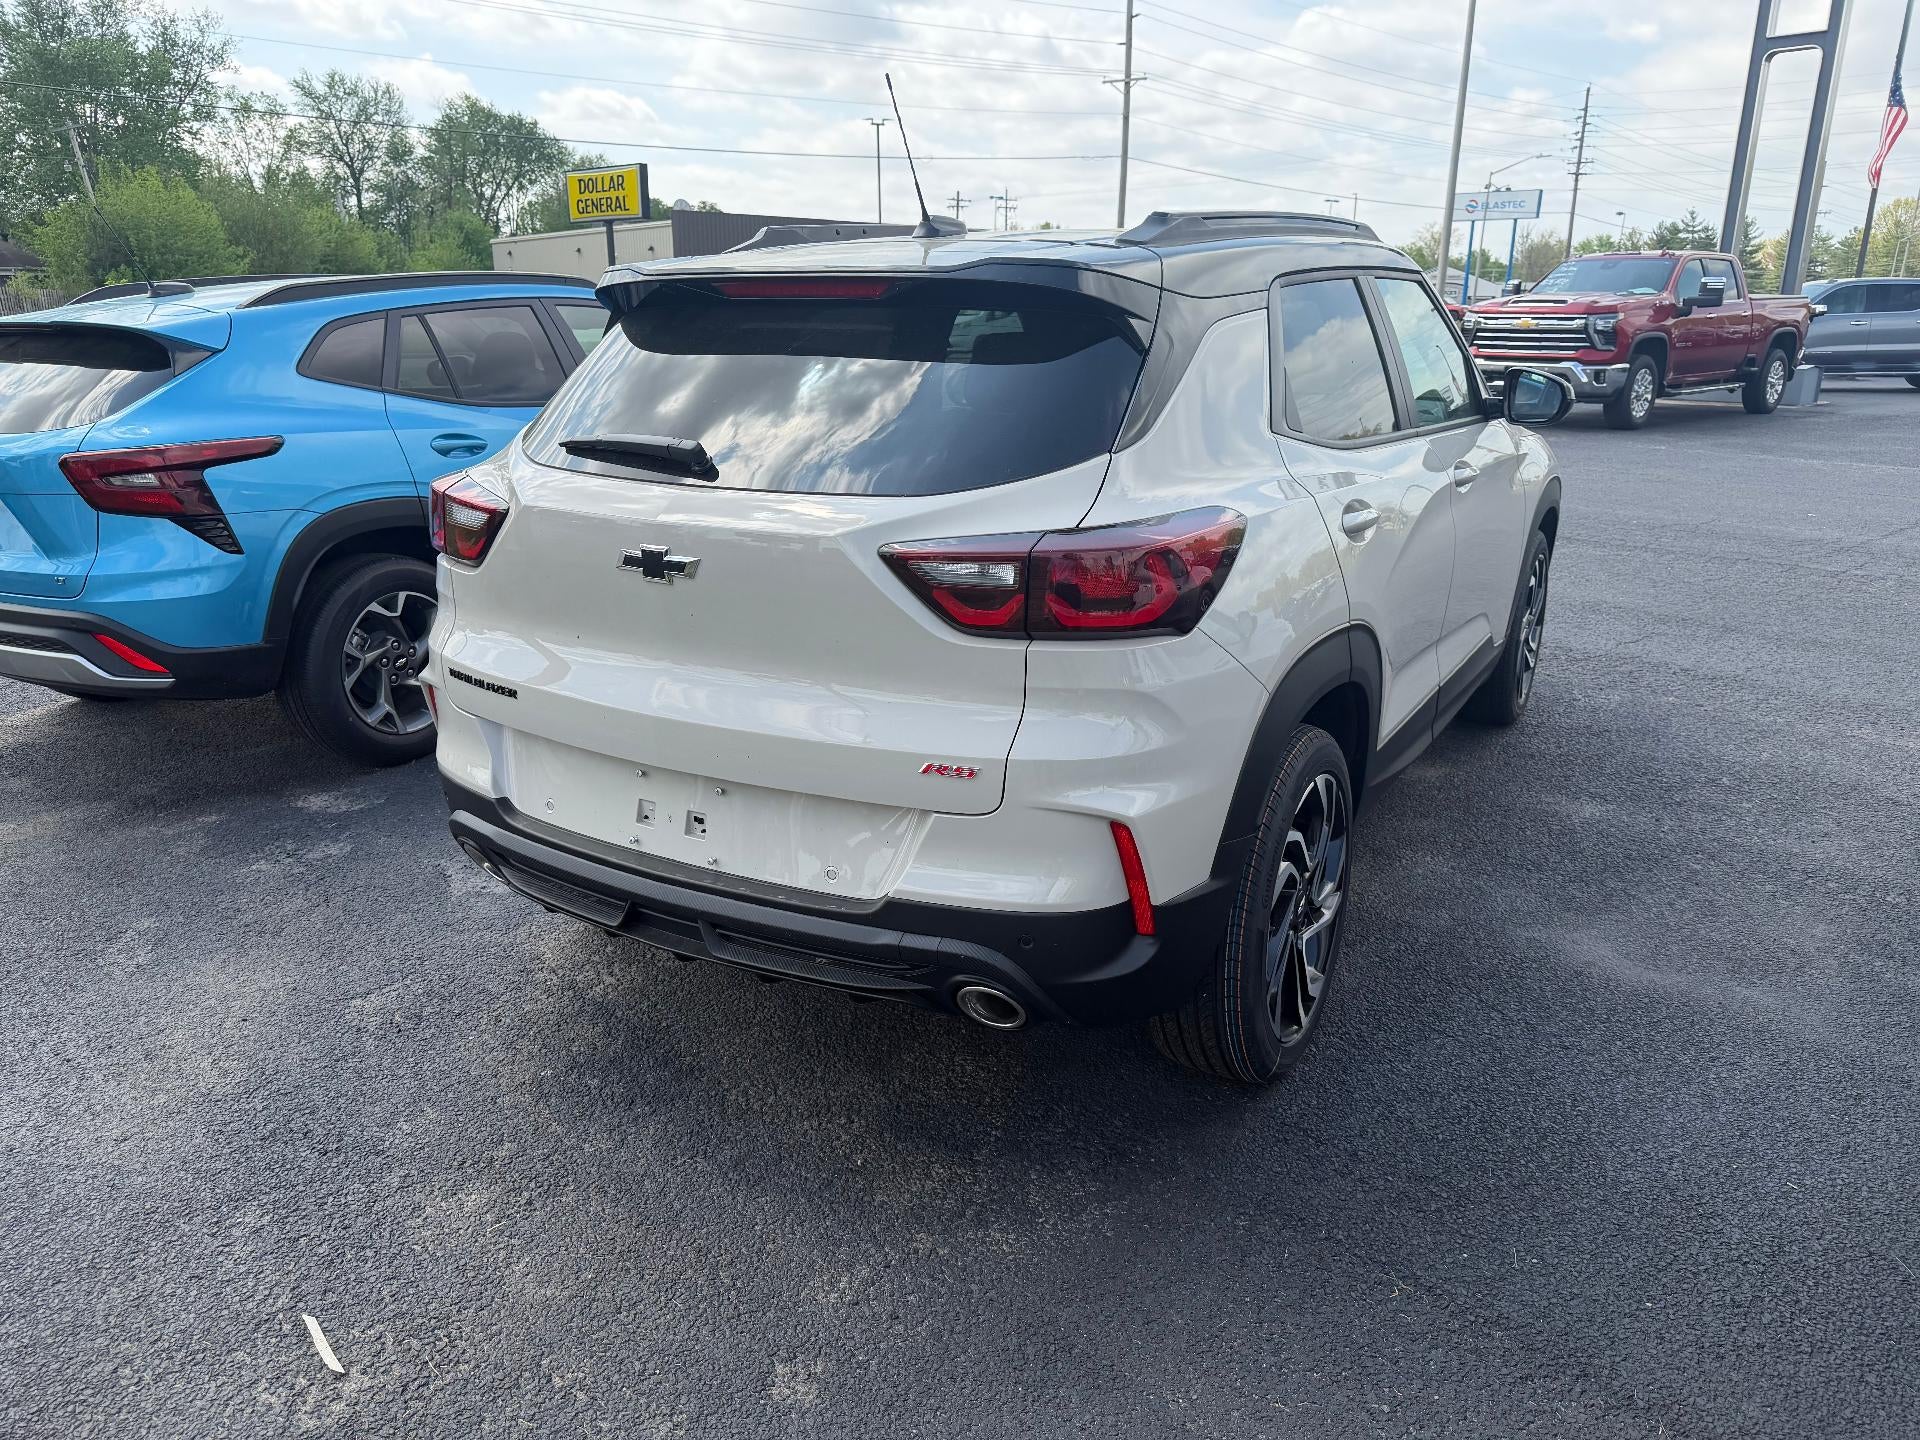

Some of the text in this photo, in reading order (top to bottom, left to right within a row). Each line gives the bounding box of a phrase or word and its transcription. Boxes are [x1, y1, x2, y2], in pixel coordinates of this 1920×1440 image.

[577, 174, 625, 195] DOLLAR
[576, 195, 630, 215] GENERAL
[918, 762, 980, 779] RS
